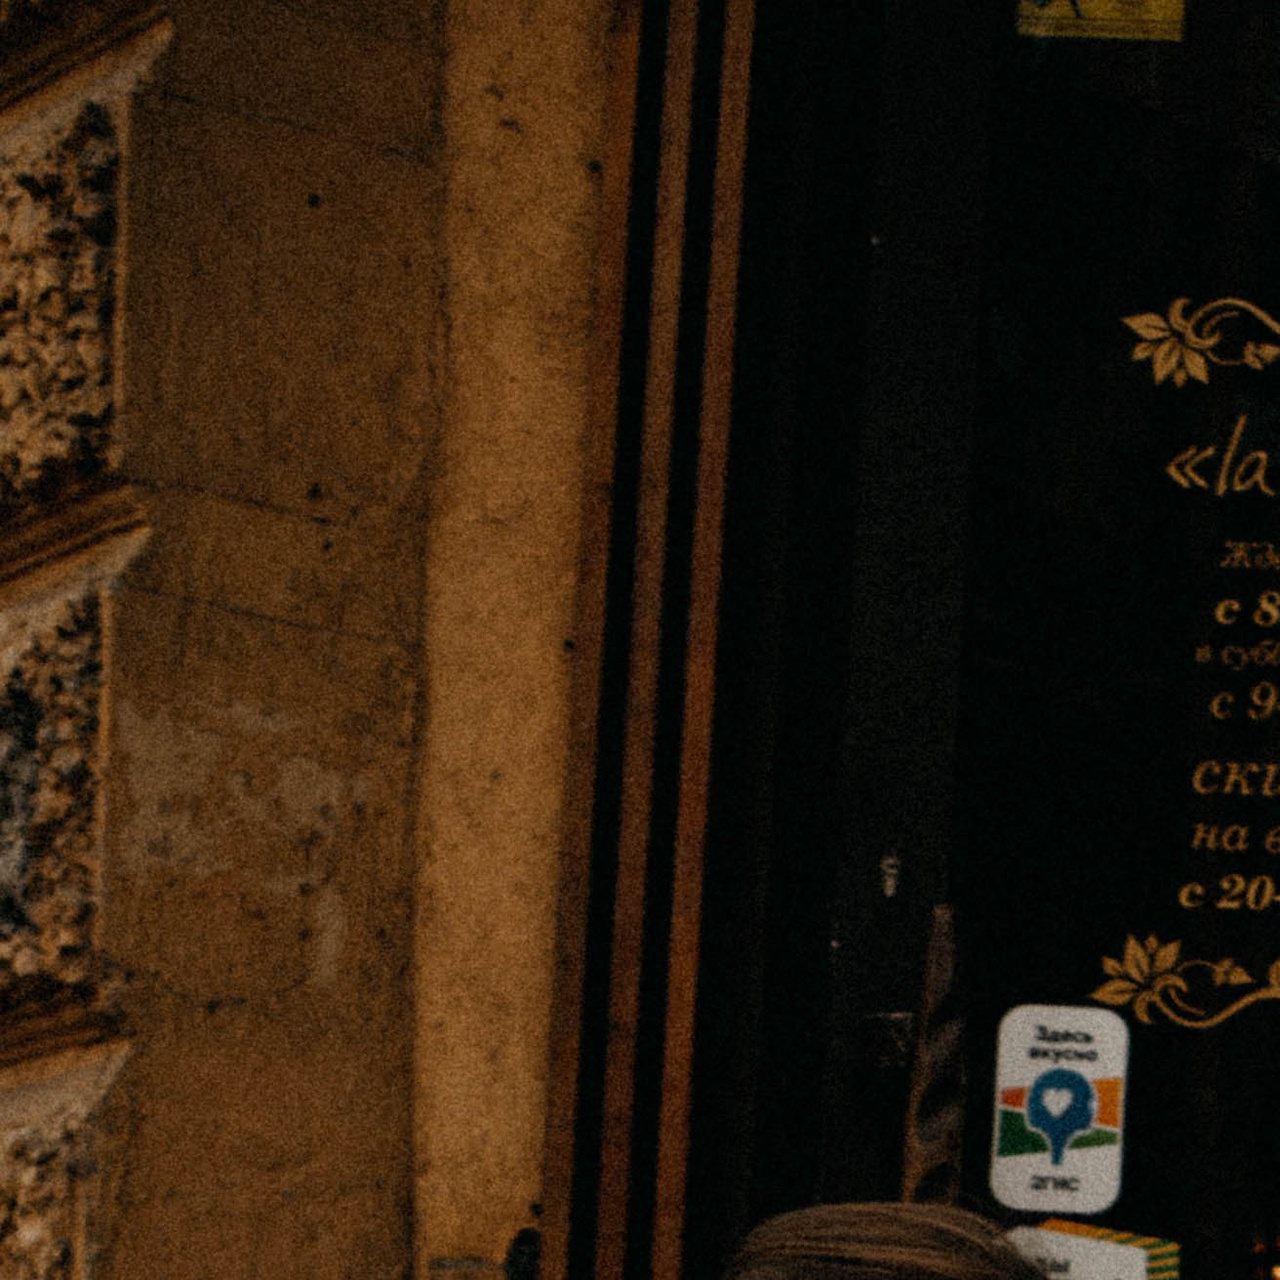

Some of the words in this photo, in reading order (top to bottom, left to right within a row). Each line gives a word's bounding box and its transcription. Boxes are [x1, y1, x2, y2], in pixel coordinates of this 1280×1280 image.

[1163, 412, 1277, 499] «la
[1213, 596, 1243, 627] с
[1208, 689, 1237, 722] с
[1189, 820, 1250, 855] на
[1176, 881, 1206, 911] с
[1034, 1025, 1093, 1044] Здесь
